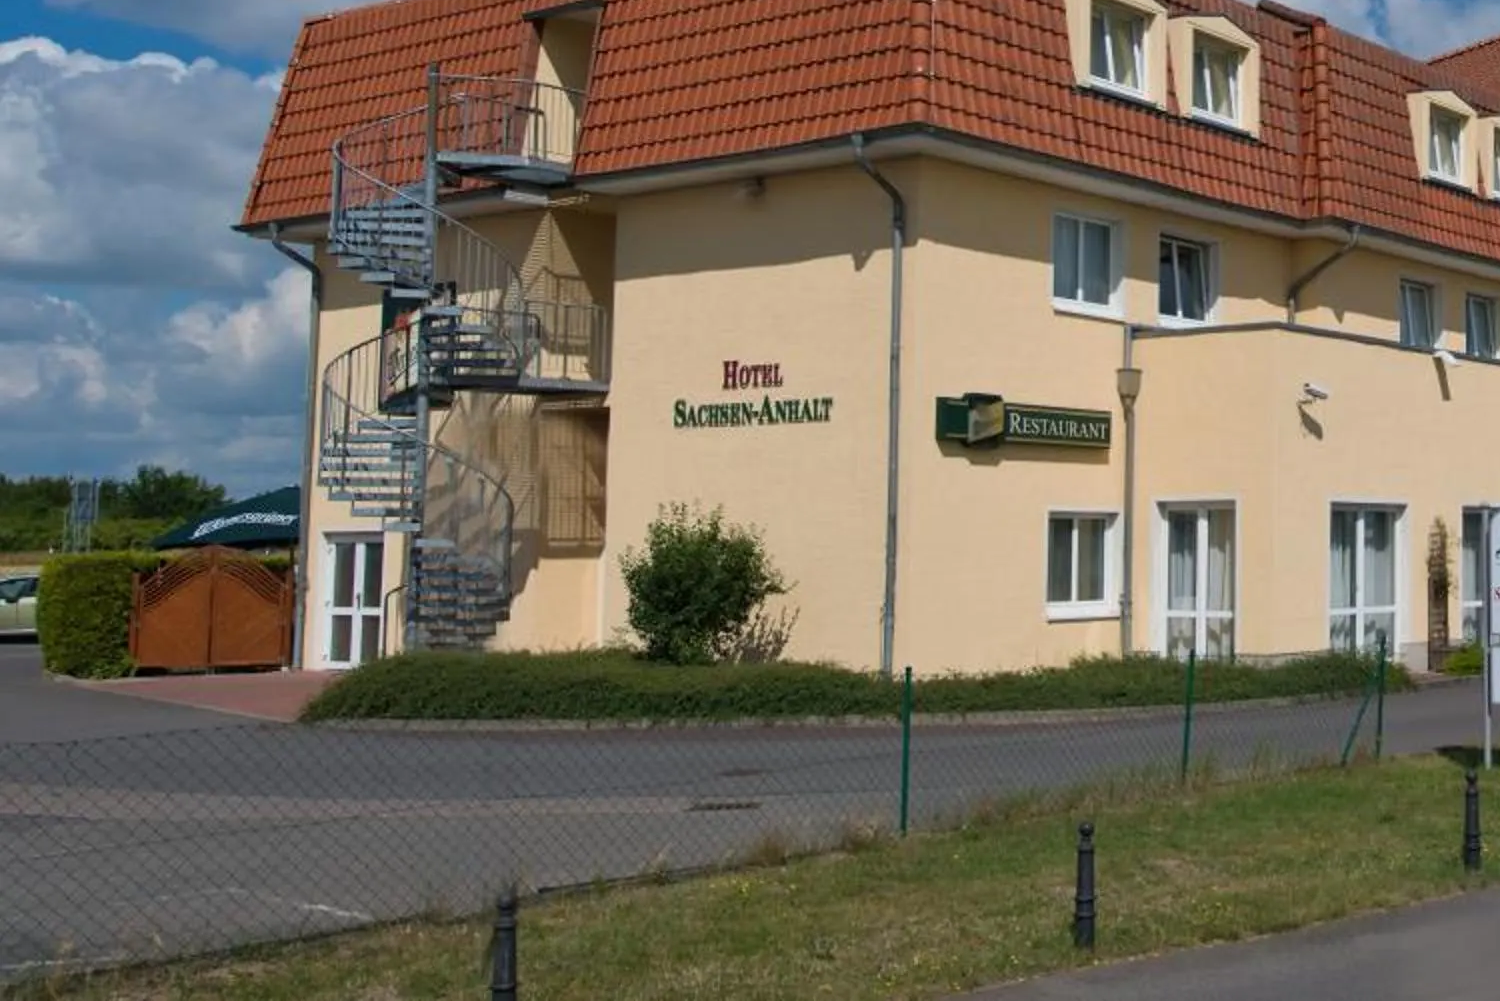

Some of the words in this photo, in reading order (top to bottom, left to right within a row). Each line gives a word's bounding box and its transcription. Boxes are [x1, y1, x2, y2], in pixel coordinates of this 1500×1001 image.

[722, 360, 784, 390] HOTEL
[673, 395, 833, 428] SACHSEN-ANHALT
[1009, 412, 1108, 440] RESTAURANT
